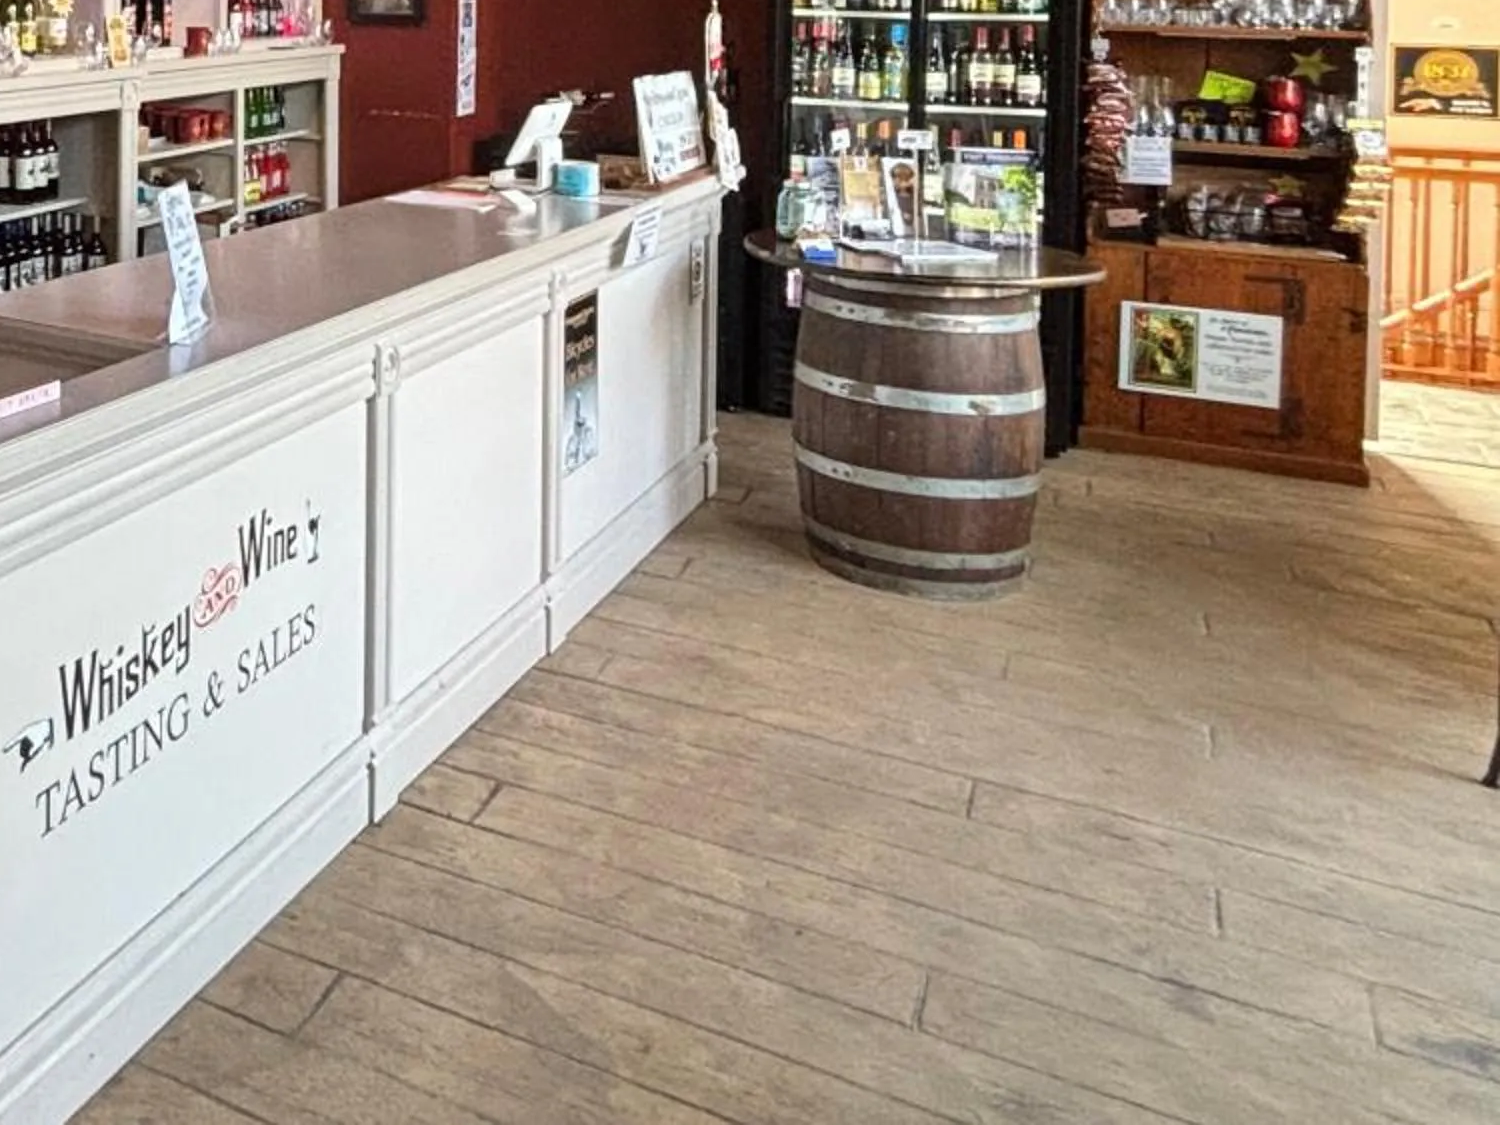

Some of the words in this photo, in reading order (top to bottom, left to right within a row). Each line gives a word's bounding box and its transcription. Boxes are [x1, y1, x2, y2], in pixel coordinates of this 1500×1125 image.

[35, 692, 190, 838] TASTING
[202, 670, 225, 719] &
[236, 603, 316, 694] SALES
[58, 604, 191, 740] Whiskey
[201, 575, 237, 620] AND
[237, 508, 298, 588] Wine
